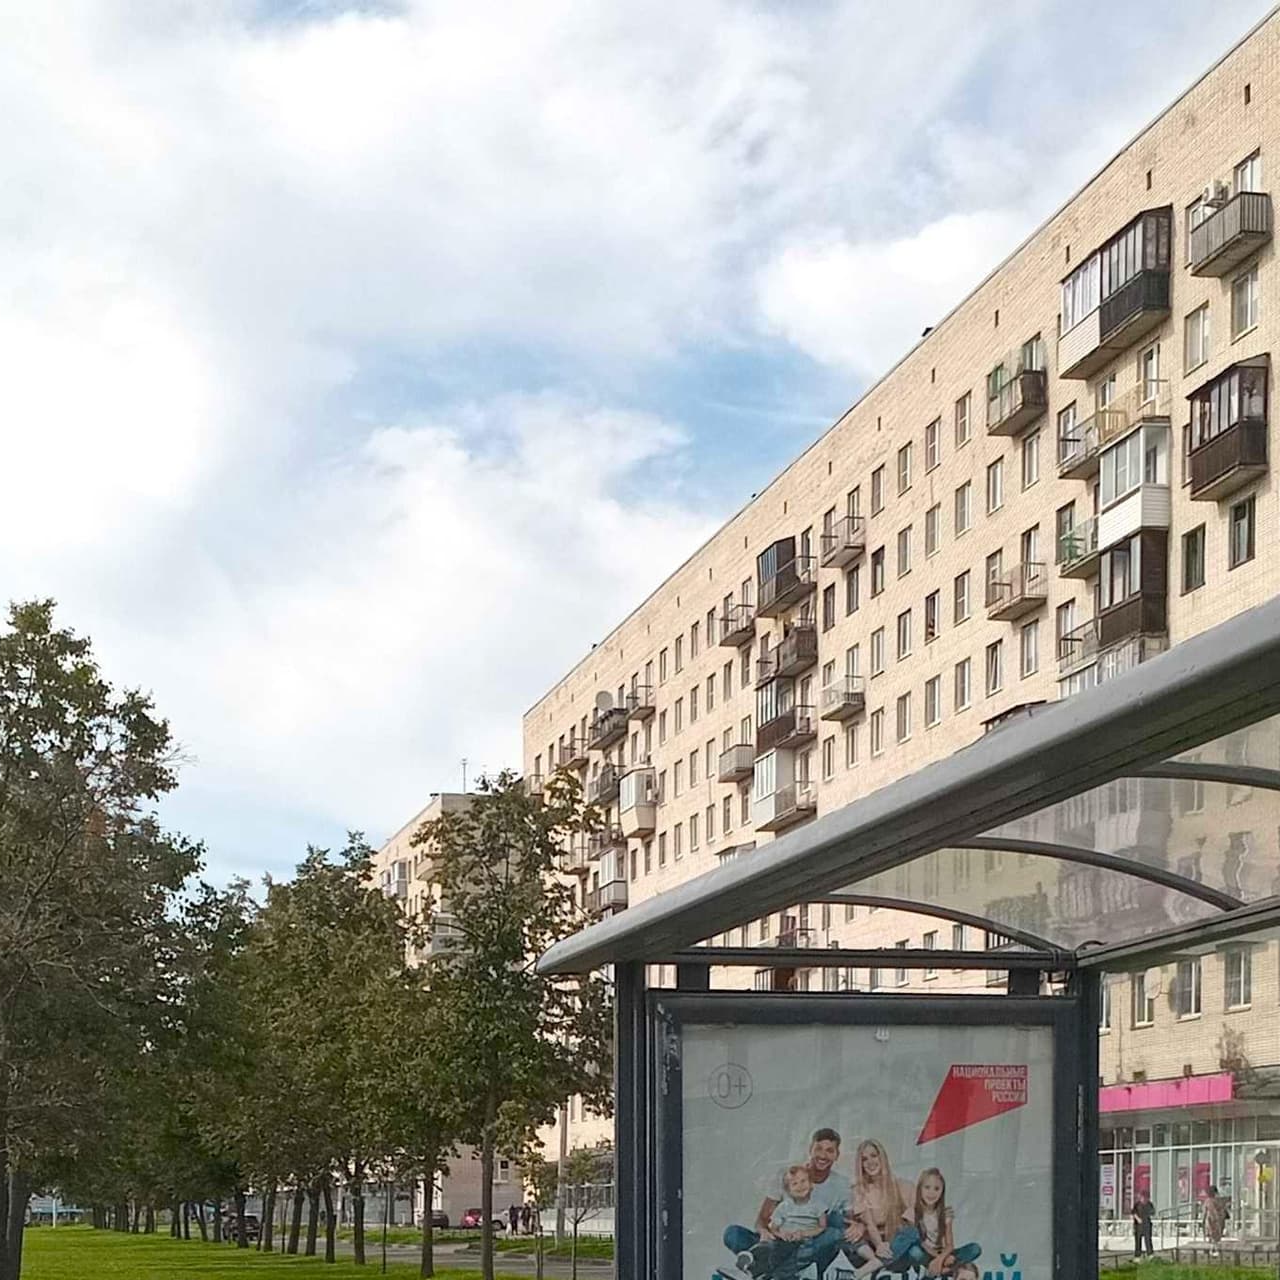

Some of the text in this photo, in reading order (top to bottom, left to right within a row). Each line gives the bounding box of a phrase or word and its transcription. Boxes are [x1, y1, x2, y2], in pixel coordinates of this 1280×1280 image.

[952, 1066, 1026, 1079] НАЦИОНАЛЬНЫЕ
[719, 1071, 747, 1099] 0+
[984, 1079, 1026, 1090] ПРОЕКТЫ
[992, 1091, 1026, 1102] РОССИИ
